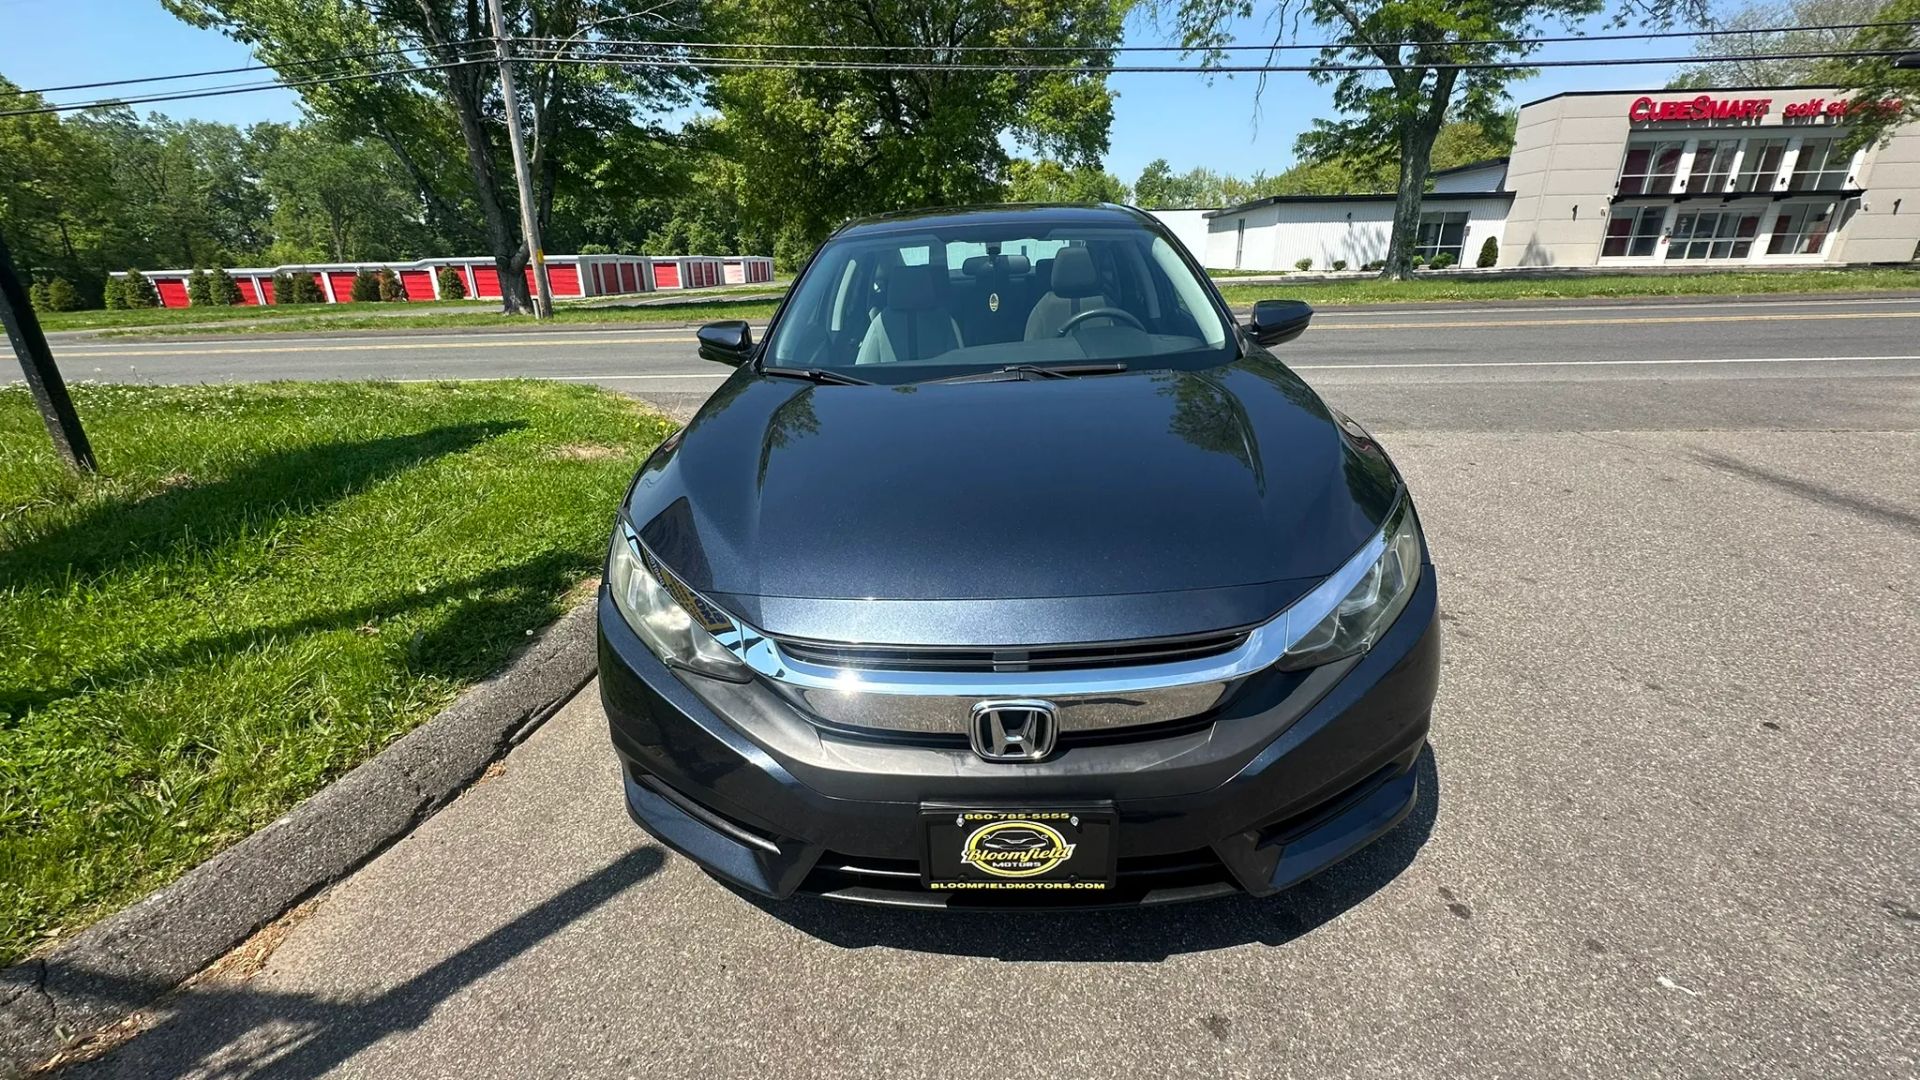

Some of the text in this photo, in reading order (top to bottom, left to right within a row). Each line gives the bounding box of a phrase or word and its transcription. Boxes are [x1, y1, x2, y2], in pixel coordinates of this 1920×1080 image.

[1784, 98, 1825, 117] self
[967, 844, 1070, 863] Bloomfield
[930, 882, 1105, 890] BLOOMFIELDMOTORS.COM
